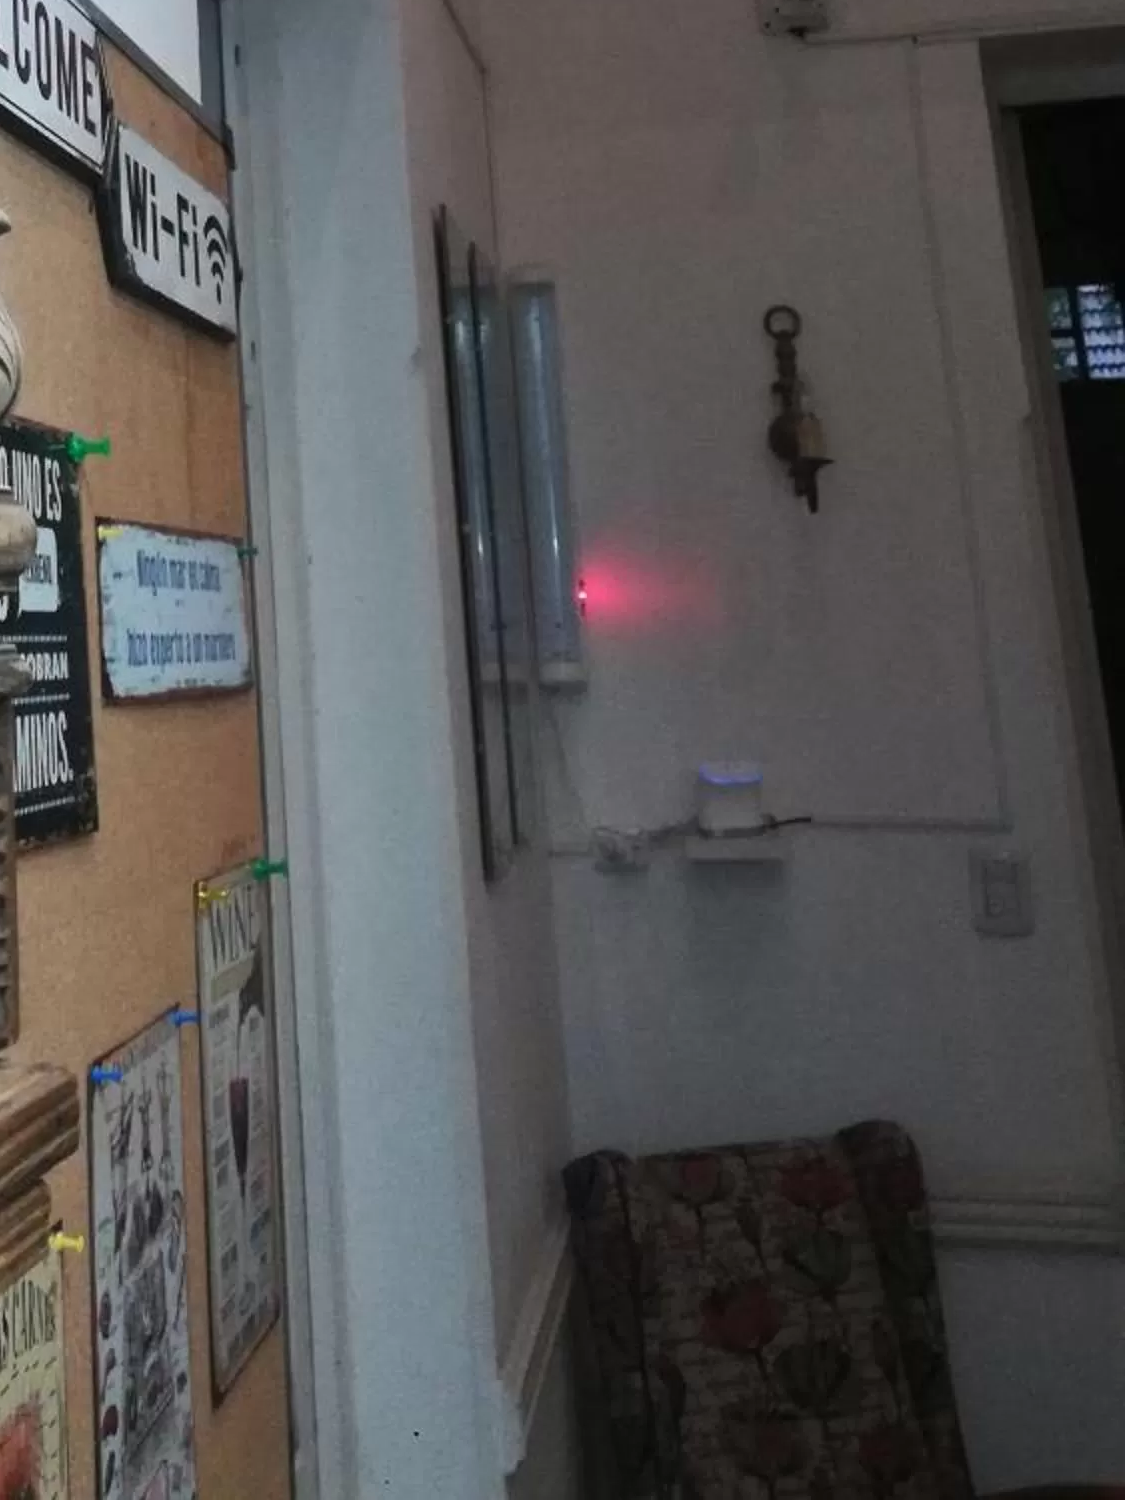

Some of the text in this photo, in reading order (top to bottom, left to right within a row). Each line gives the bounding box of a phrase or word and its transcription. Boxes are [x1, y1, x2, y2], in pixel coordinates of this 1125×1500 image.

[125, 153, 201, 287] Wi-Fi
[44, 456, 62, 521] ES
[21, 652, 70, 681] OBRAN
[13, 710, 74, 792] MINOS.
[209, 883, 257, 970] WINE
